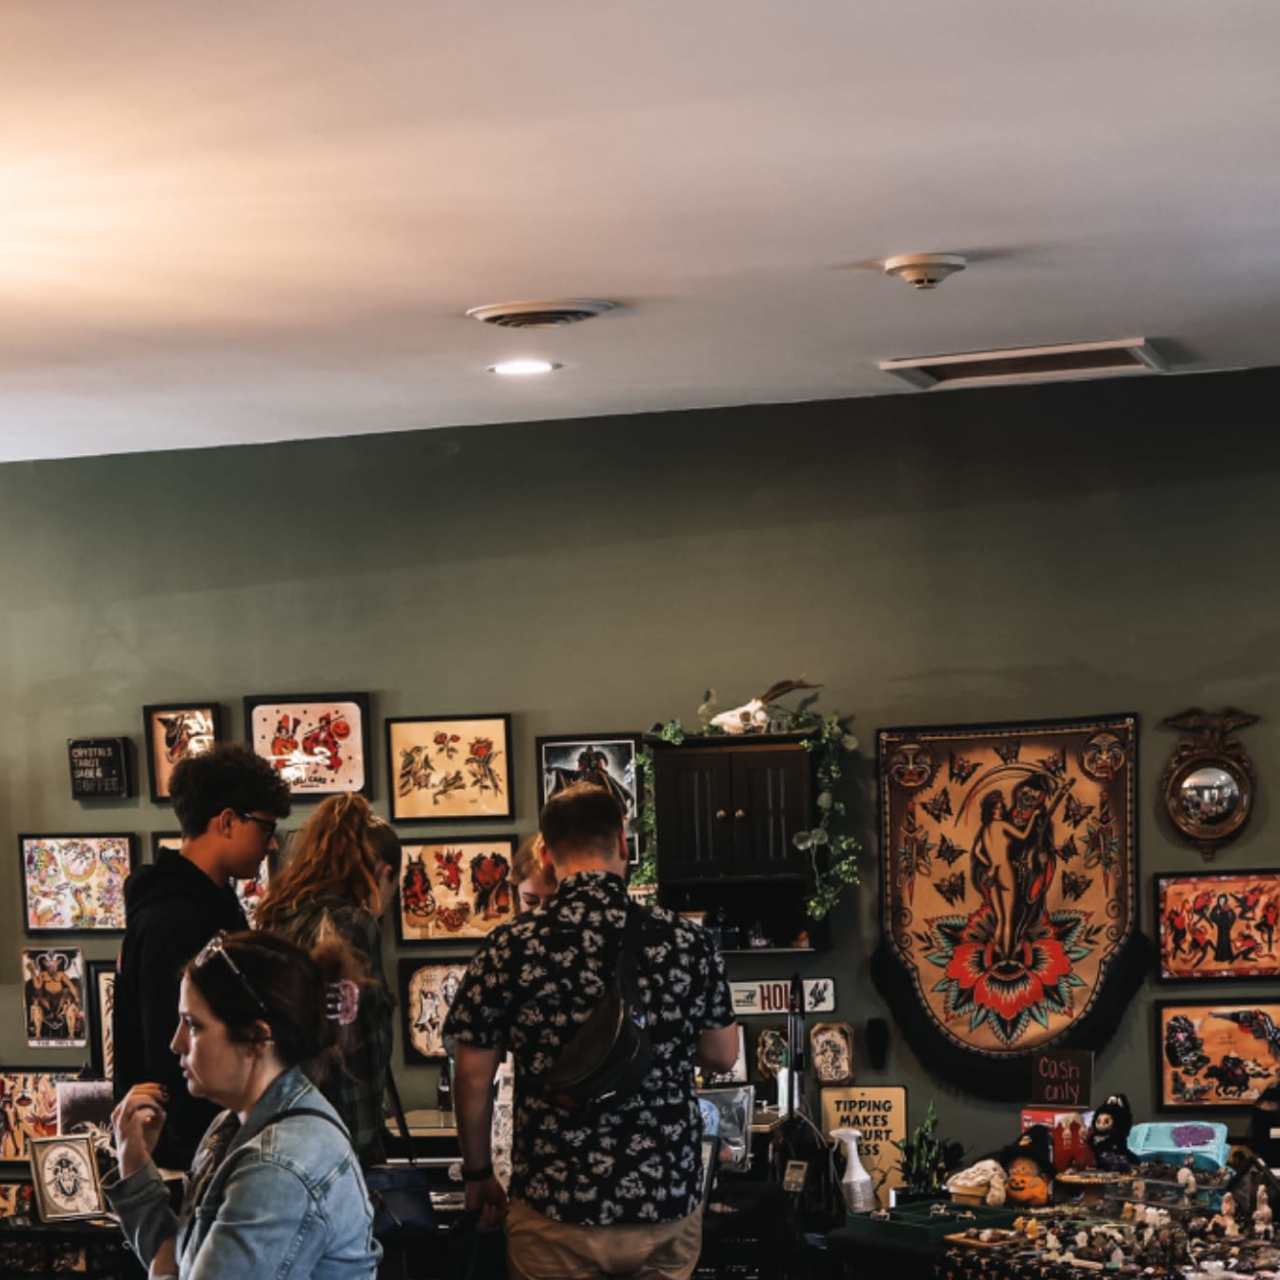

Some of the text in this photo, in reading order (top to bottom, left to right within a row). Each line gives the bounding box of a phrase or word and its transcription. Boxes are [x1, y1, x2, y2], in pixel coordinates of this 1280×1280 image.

[834, 1100, 892, 1113] TIPPING
[839, 1115, 888, 1127] MAKES
[860, 1130, 893, 1141] URT
